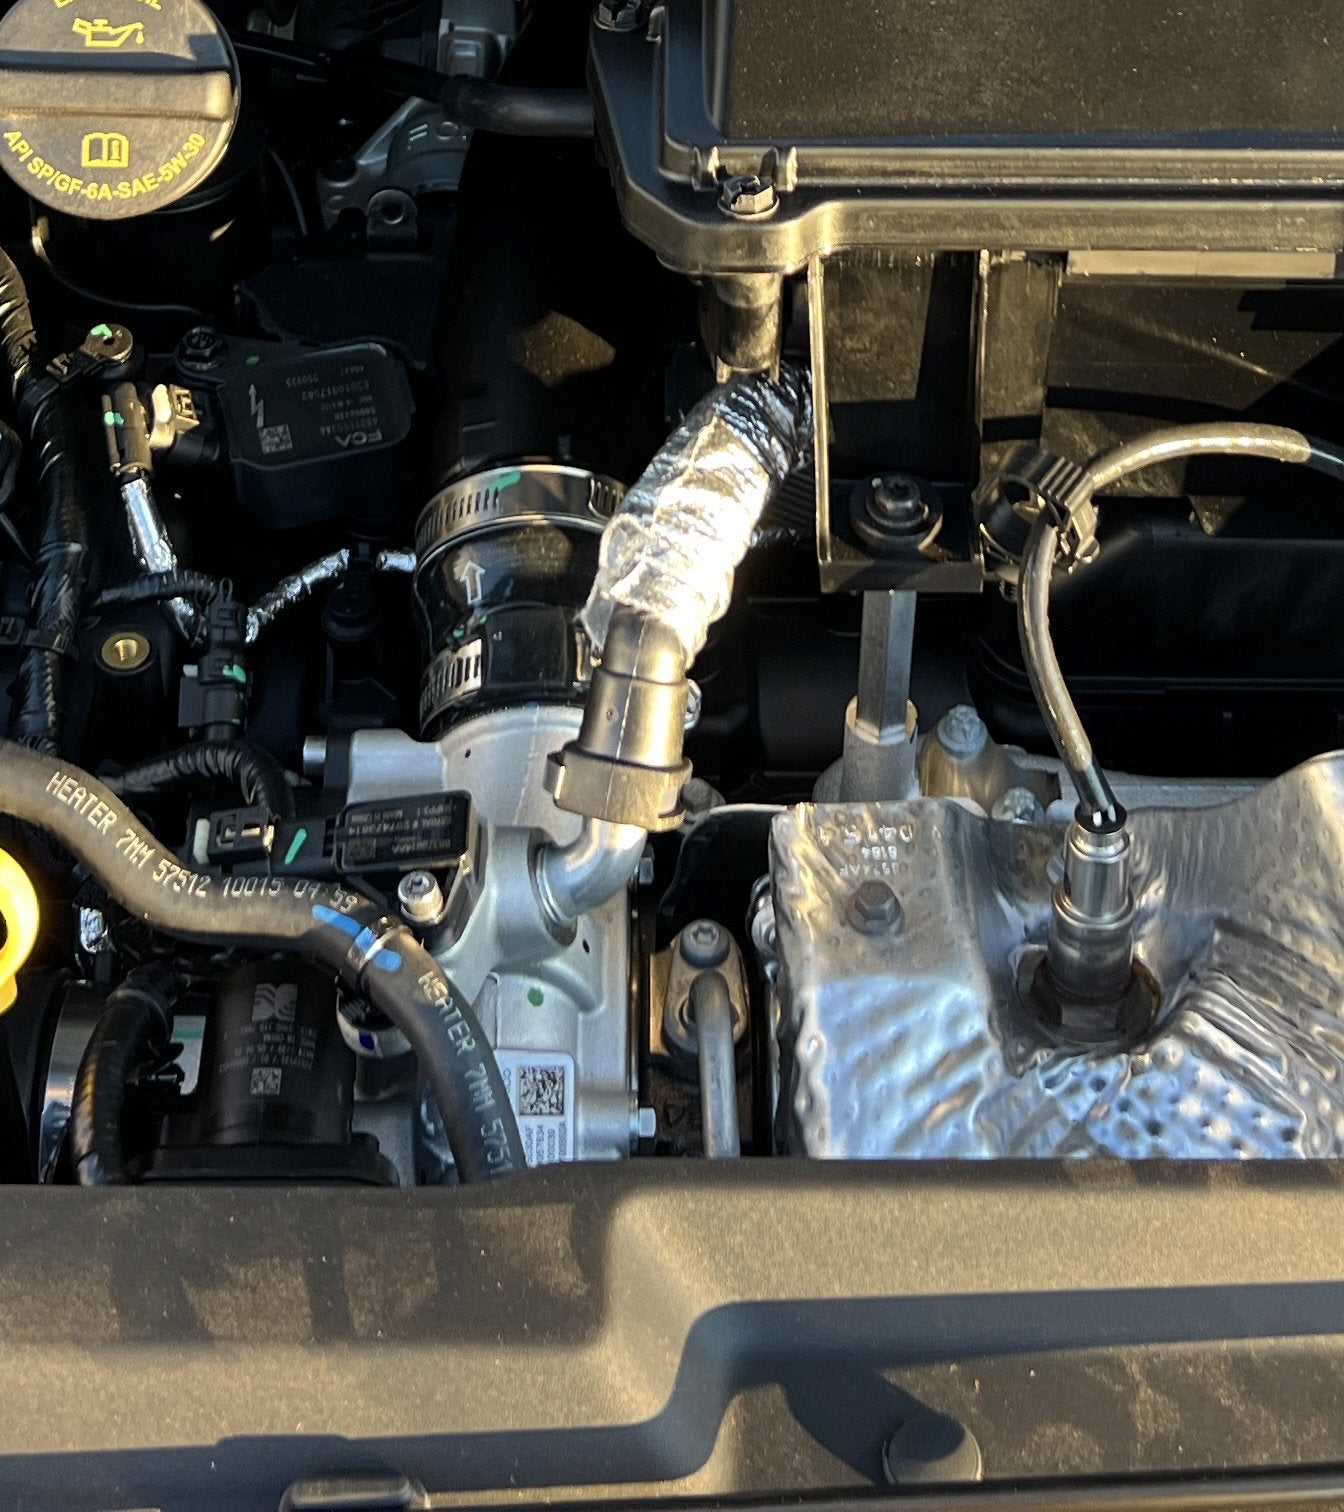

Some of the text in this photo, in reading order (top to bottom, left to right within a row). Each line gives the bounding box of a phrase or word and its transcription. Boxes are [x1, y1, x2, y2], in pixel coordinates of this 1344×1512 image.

[3, 130, 28, 163] API
[45, 771, 118, 834] HEATER
[115, 827, 157, 869] 7MM
[417, 970, 477, 1057] HEATER
